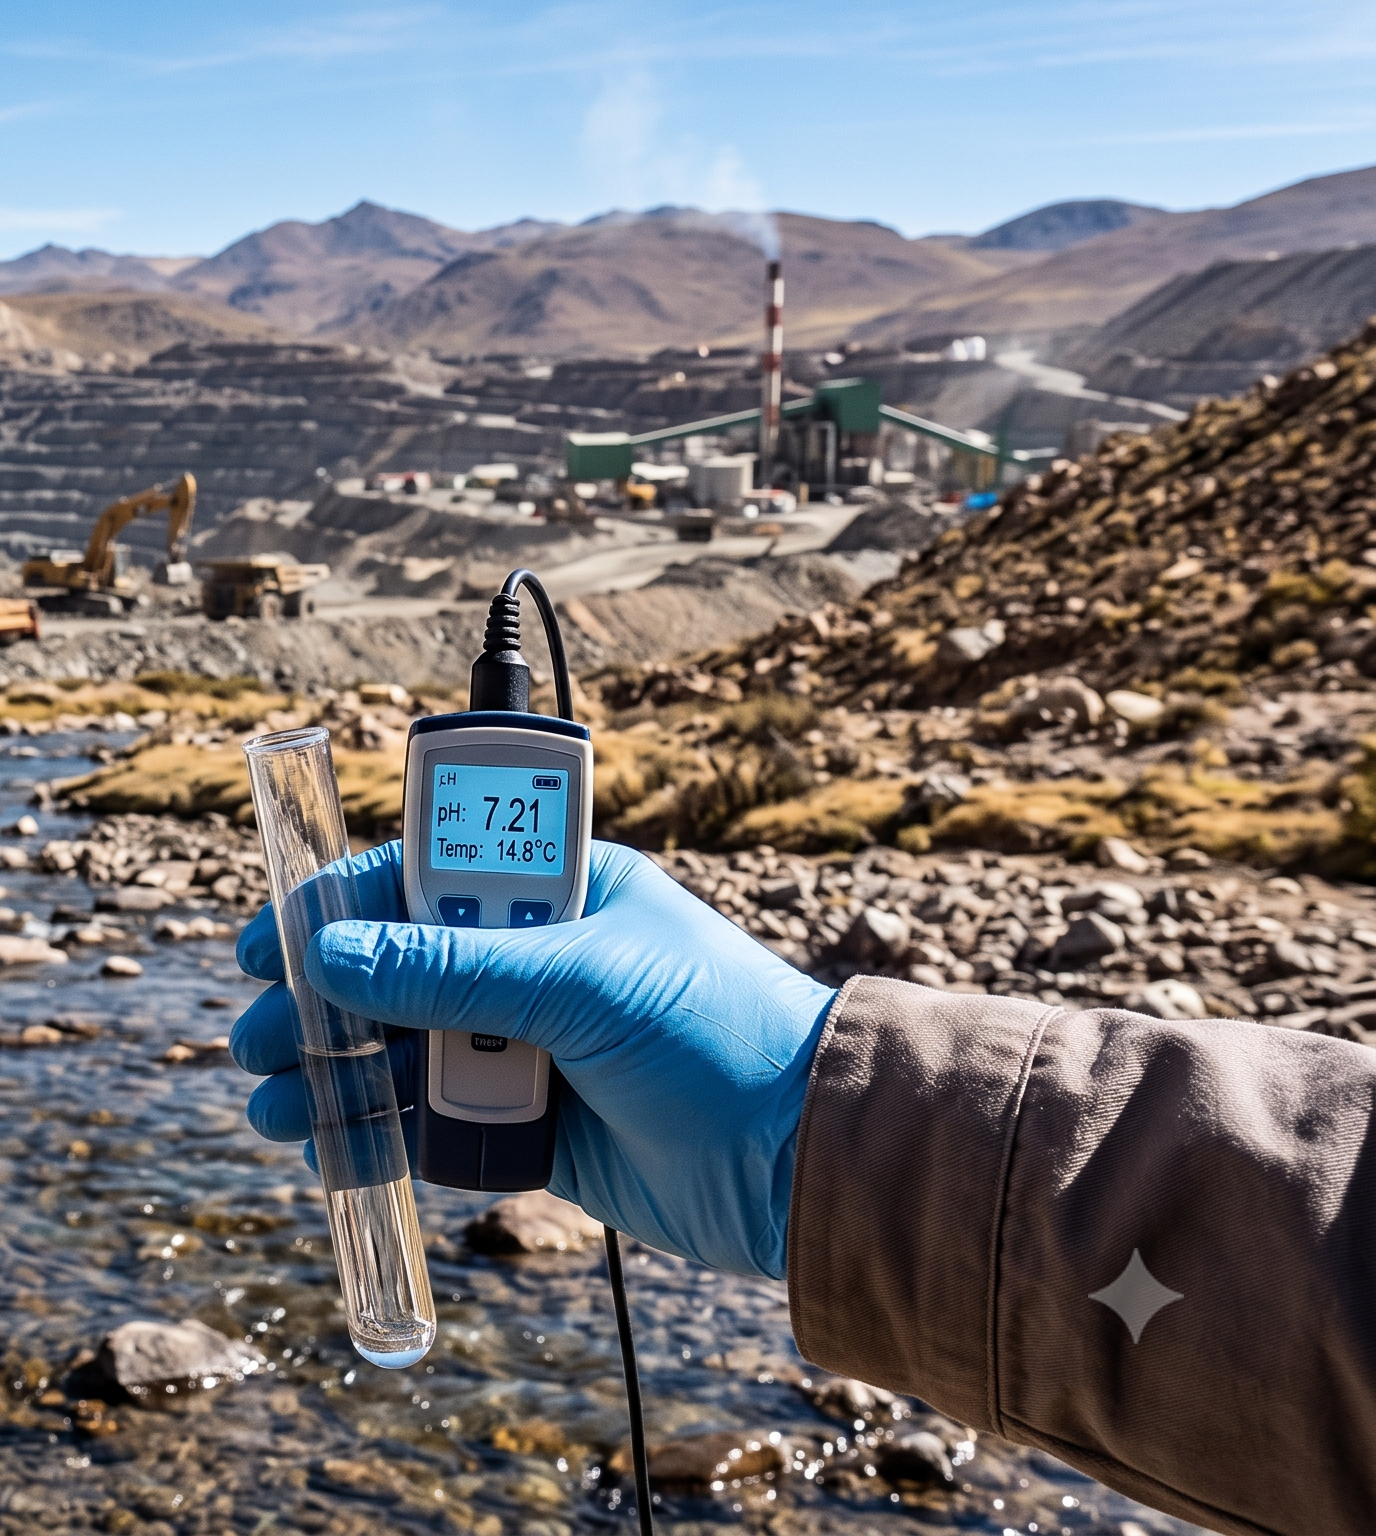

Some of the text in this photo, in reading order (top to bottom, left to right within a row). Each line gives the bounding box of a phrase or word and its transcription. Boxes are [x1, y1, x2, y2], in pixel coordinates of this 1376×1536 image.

[437, 796, 540, 833] pH: 7.21
[437, 837, 556, 863] Temp: 14.8°C
